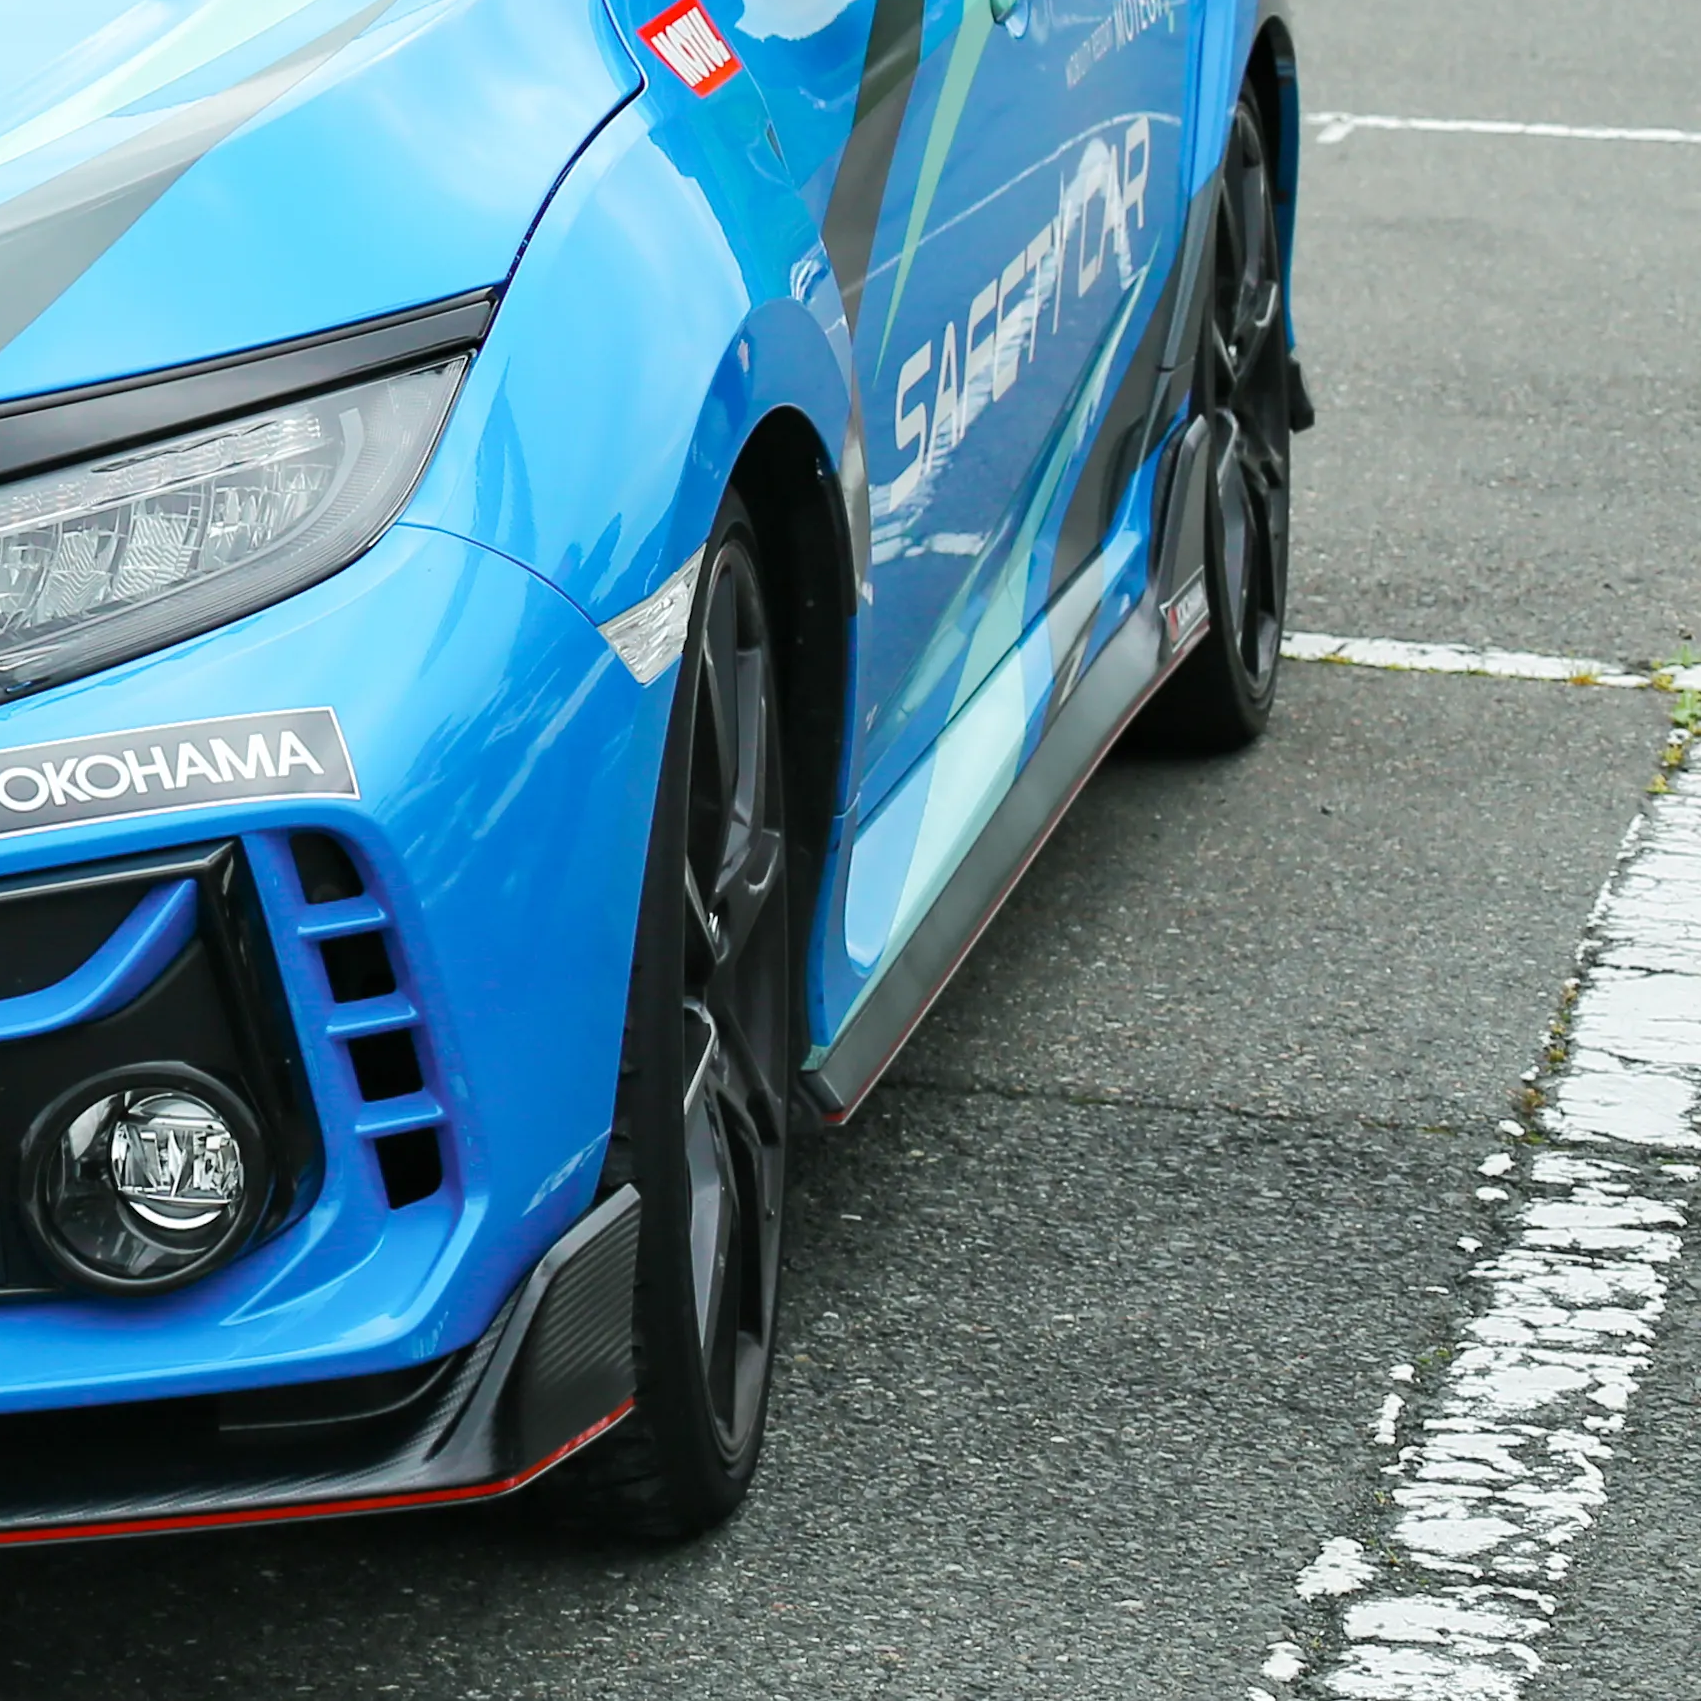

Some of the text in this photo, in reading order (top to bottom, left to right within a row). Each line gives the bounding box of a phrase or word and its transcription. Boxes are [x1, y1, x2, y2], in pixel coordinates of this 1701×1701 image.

[650, 6, 733, 88] MOTUL
[890, 116, 1150, 512] SAFETY CAR
